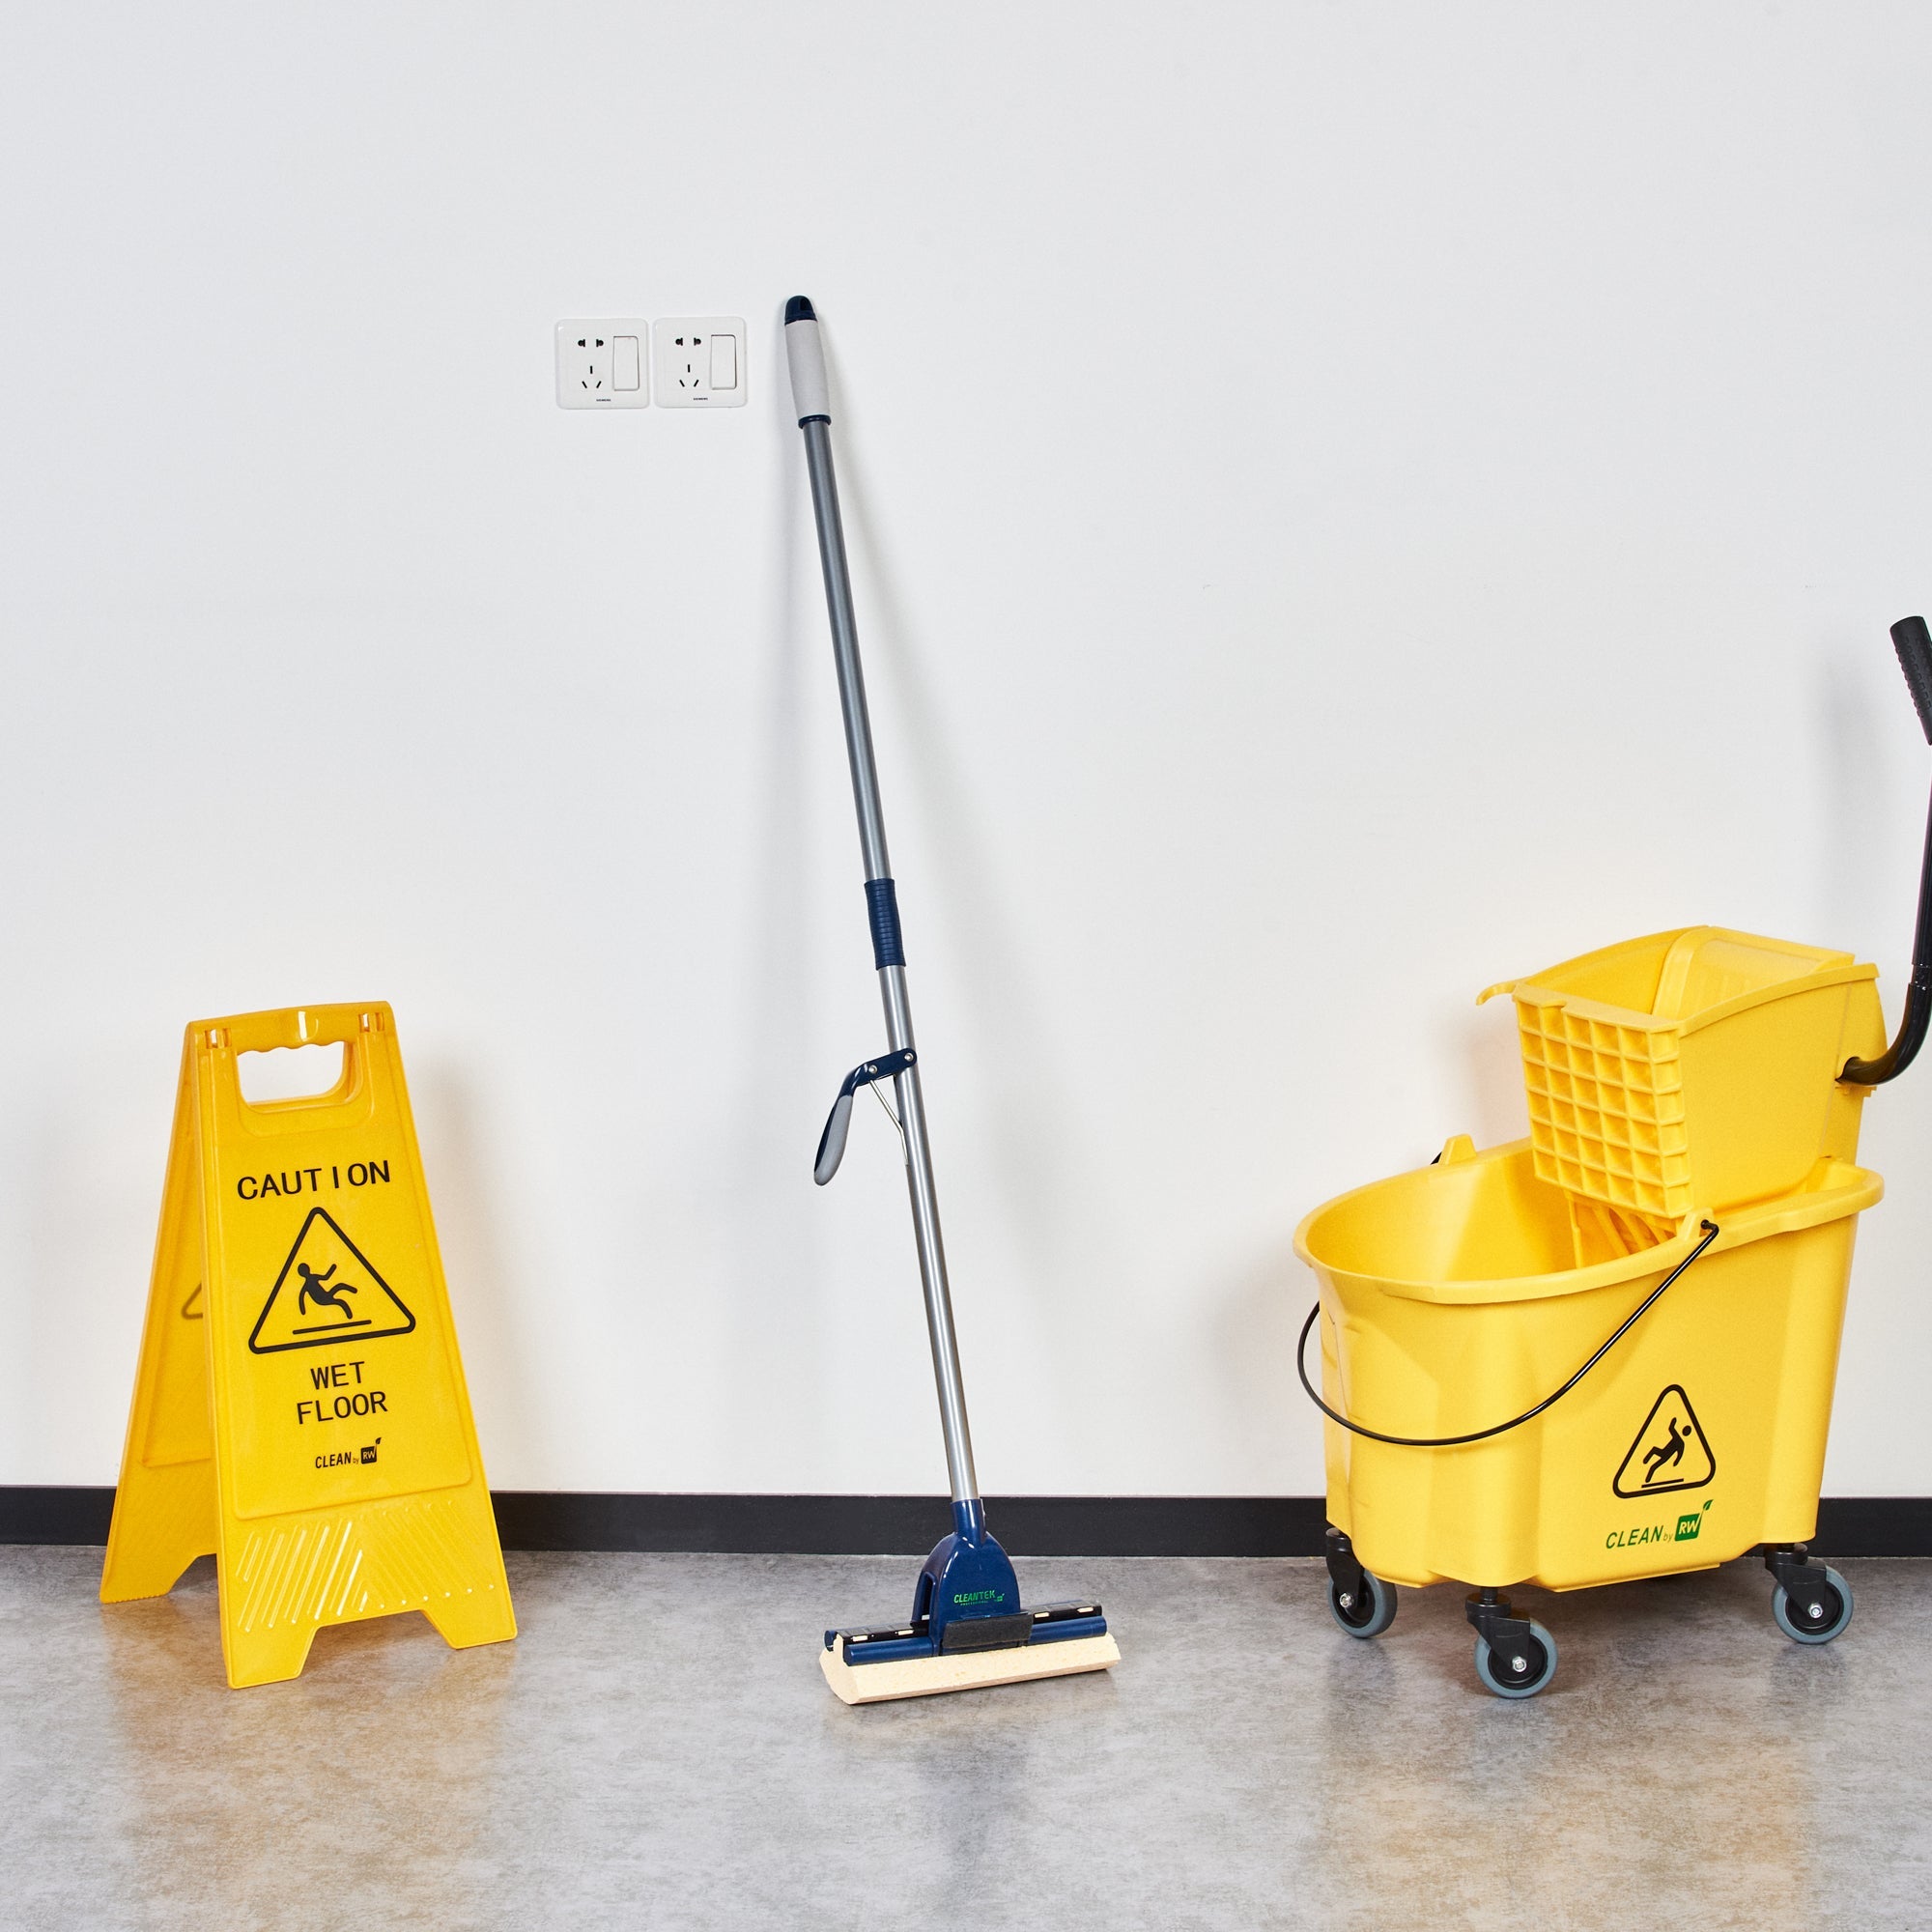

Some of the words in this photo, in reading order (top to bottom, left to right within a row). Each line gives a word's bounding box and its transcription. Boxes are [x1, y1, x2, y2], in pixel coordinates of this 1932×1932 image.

[237, 1160, 390, 1200] CAUTION
[310, 1361, 365, 1390] WET
[297, 1391, 388, 1425] FLOOR
[315, 1452, 352, 1468] CLEAN
[1605, 1525, 1663, 1549] CLEAN
[1663, 1532, 1673, 1543] by
[1678, 1517, 1700, 1535] RW
[953, 1590, 996, 1604] CLEANTEK
